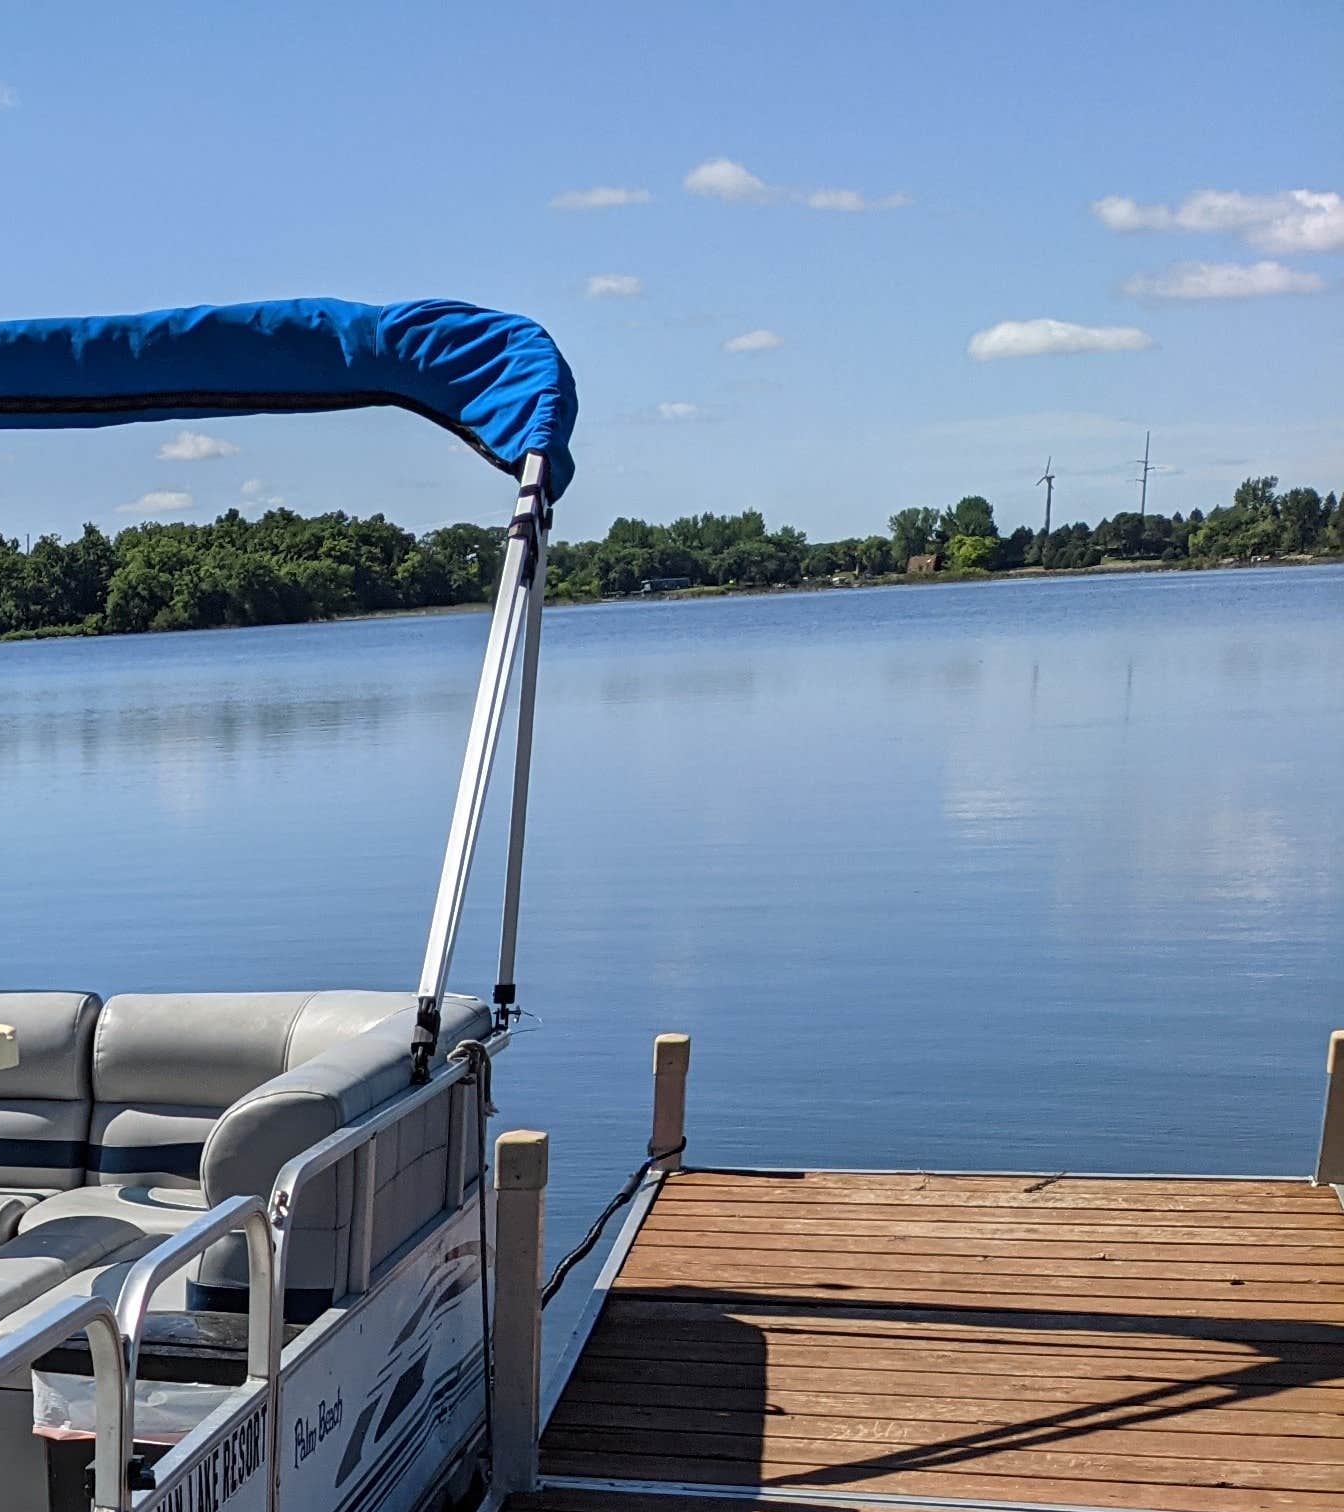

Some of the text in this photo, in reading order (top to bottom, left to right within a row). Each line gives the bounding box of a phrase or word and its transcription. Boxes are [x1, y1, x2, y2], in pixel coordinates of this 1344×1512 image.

[223, 1404, 268, 1503] RESORT
[294, 1385, 342, 1469] Palm Beach
